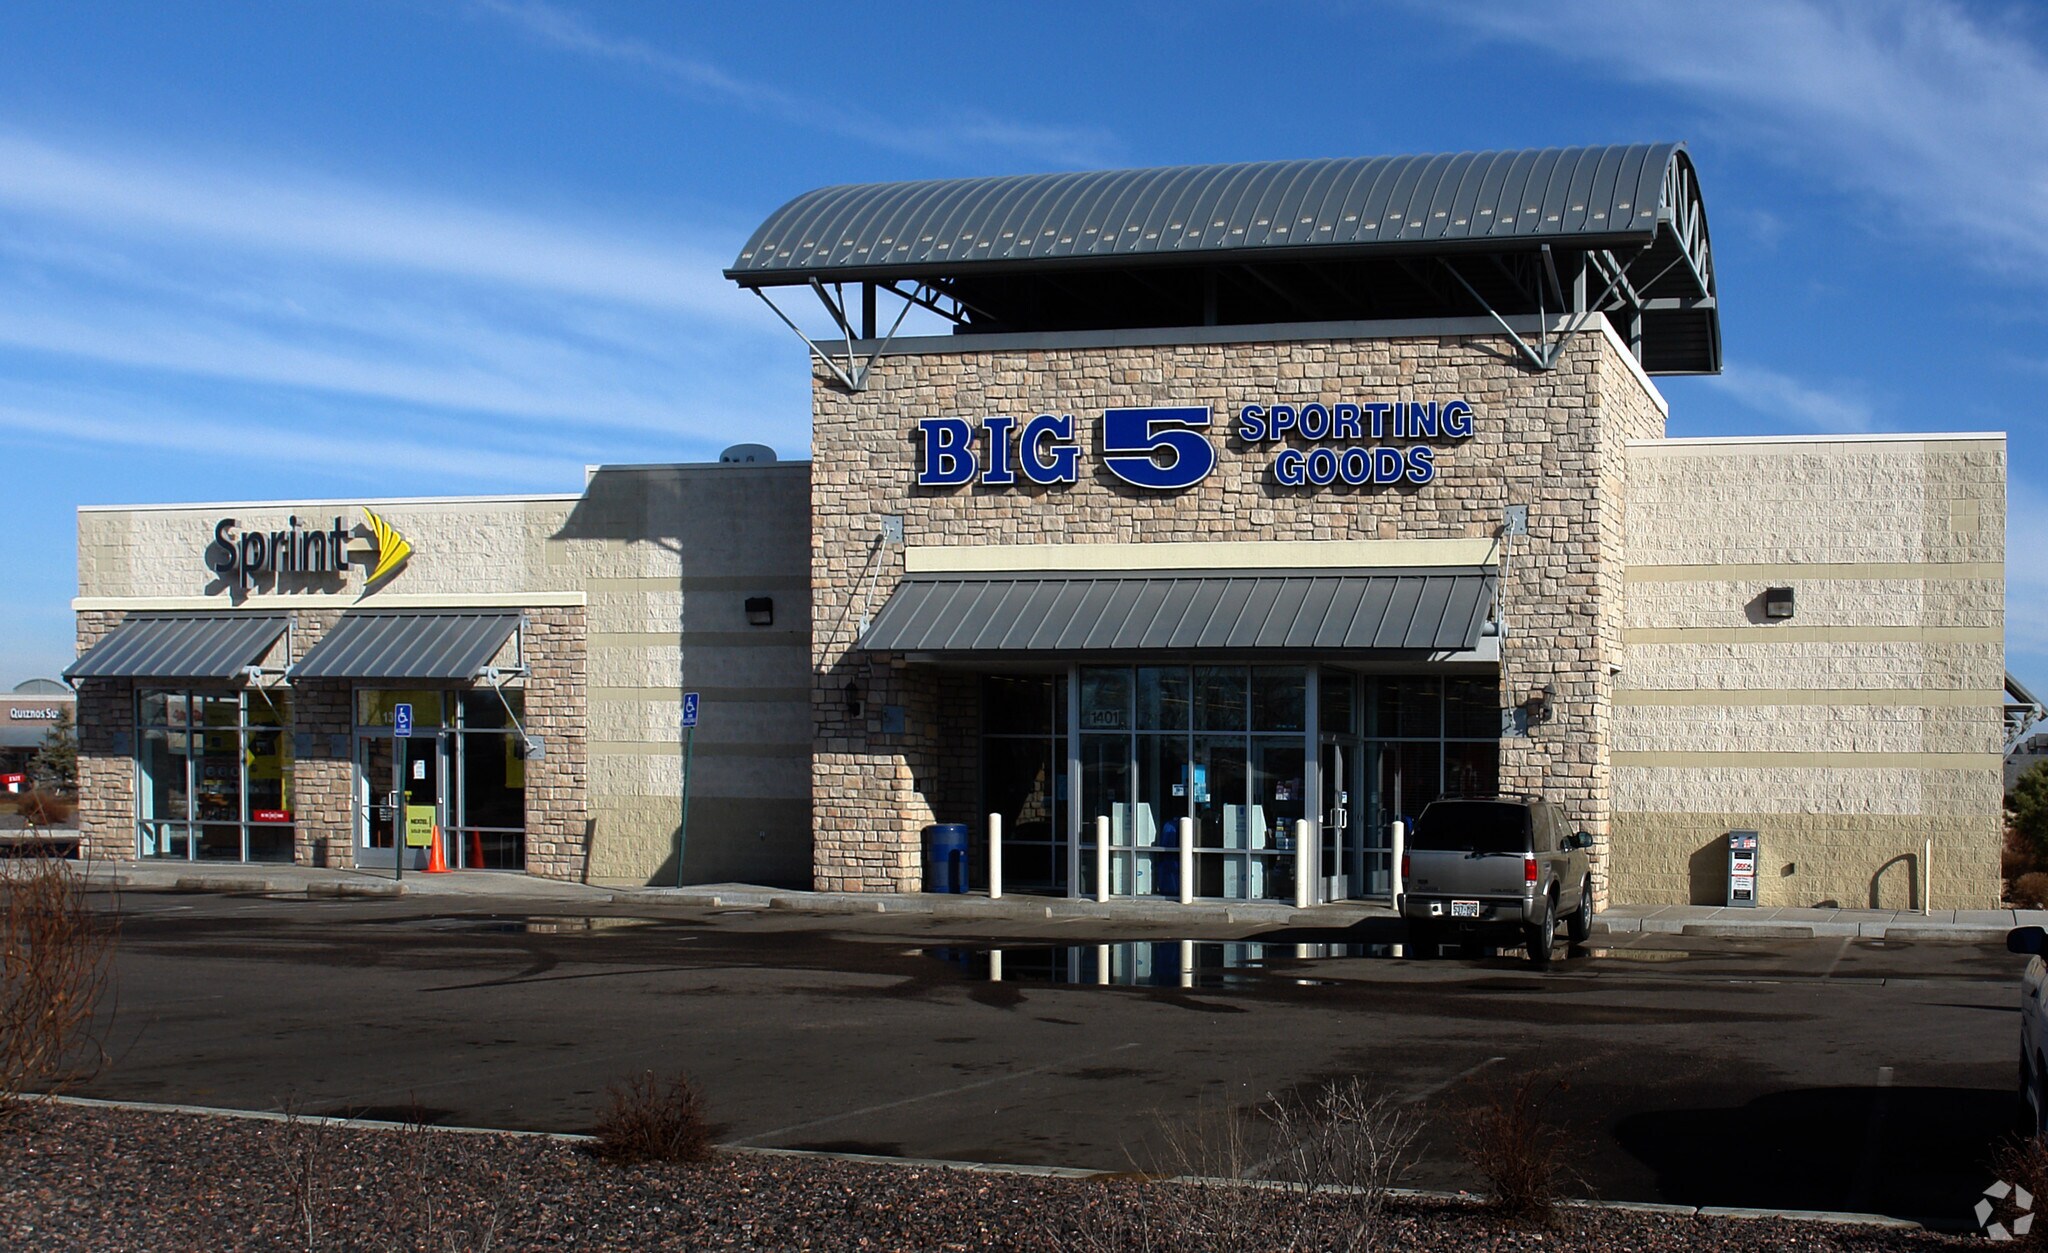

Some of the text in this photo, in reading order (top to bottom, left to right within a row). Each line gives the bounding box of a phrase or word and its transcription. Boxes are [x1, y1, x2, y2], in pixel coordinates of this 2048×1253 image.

[1238, 400, 1475, 442] SPORTING
[917, 405, 1215, 489] BIG 5
[1273, 446, 1436, 486] GOODS
[214, 514, 351, 588] Sprint
[10, 707, 60, 719] Quiznos Su
[1090, 710, 1118, 724] 1401
